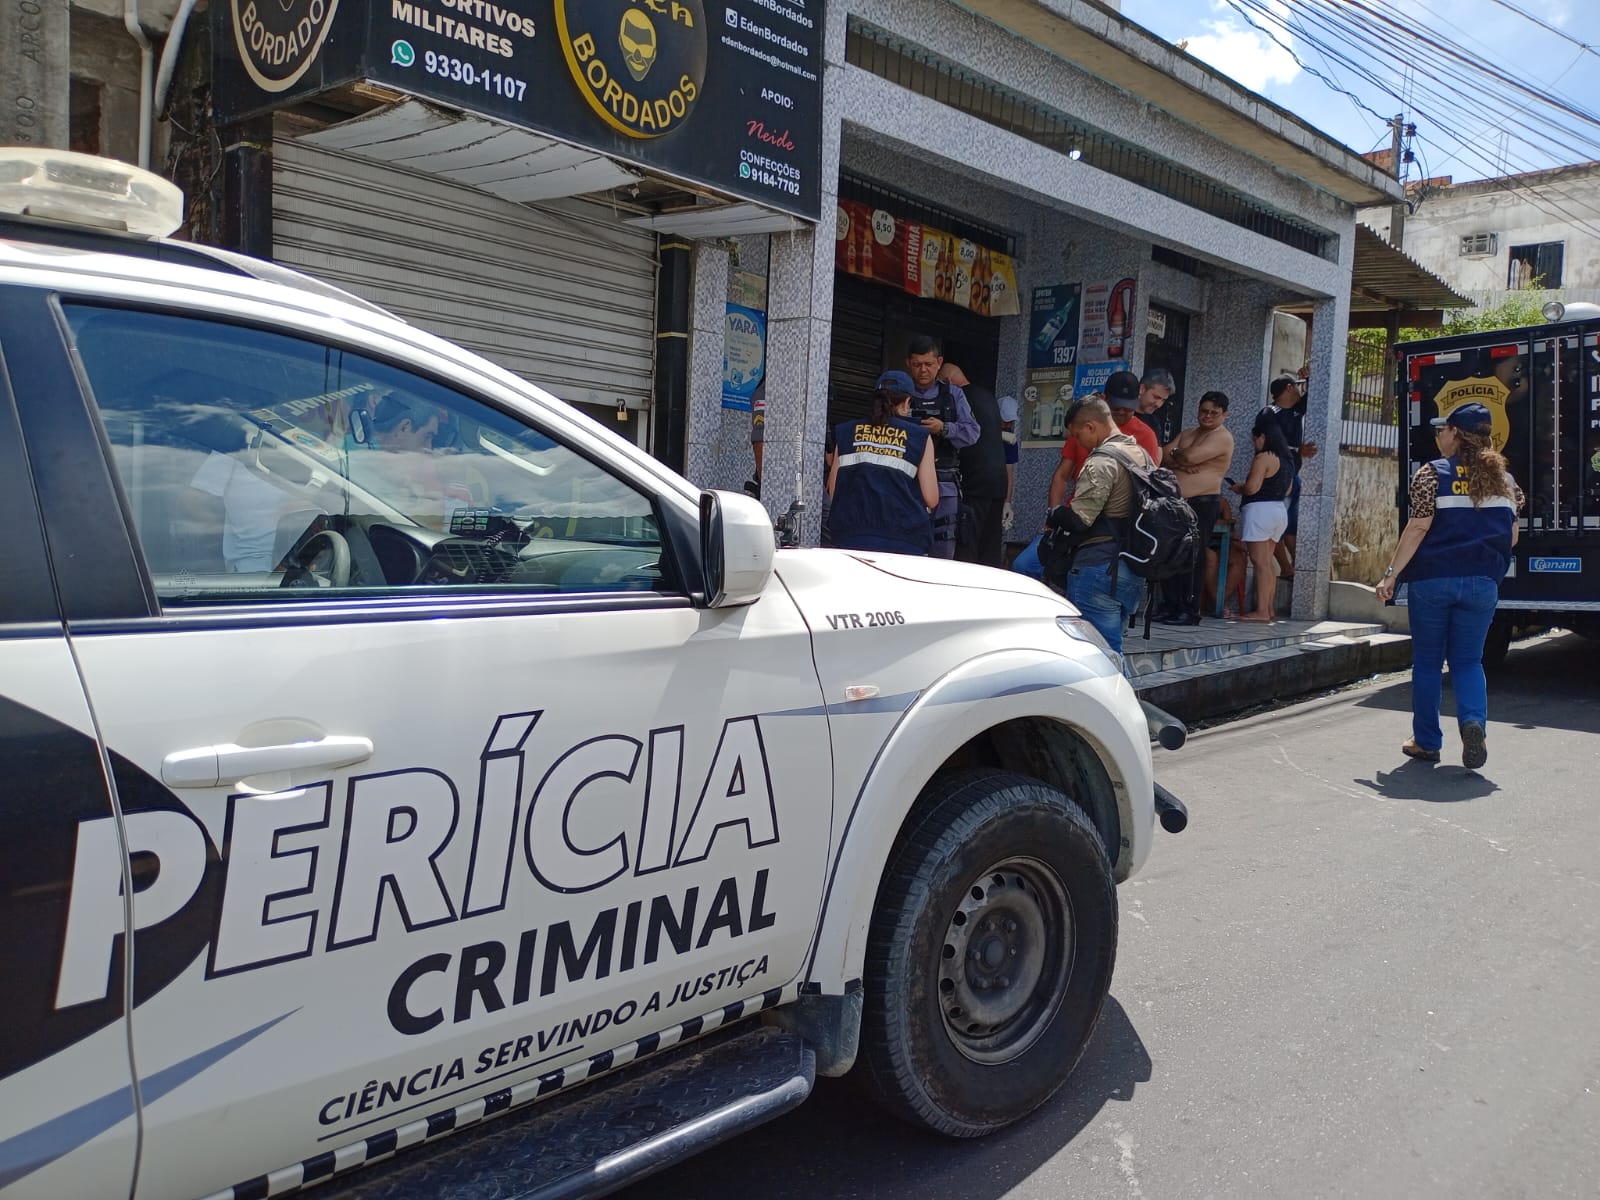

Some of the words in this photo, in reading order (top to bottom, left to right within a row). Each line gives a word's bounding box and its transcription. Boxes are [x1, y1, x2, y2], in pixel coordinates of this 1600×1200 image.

[392, 0, 514, 58] MILITARES
[740, 16, 809, 57] EdenBordados
[424, 50, 527, 102] 9330-1107
[721, 35, 817, 82] edenbordados@hotmail.com
[573, 32, 697, 130] BORDADOS
[760, 87, 794, 110] APOIO:
[746, 120, 795, 151] Neide
[740, 149, 801, 180] CONFECÇÕES
[751, 168, 800, 196] 9184-7702
[907, 225, 921, 282] BRAHMA
[1450, 386, 1495, 400] POLÍCIA
[854, 433, 907, 449] CRIMINAL
[855, 445, 904, 459] AMAZONAS
[825, 613, 864, 630] VTR
[865, 610, 905, 628] 2006
[54, 709, 780, 1011] PERÍCIA
[387, 869, 777, 1036] CRIMINAL
[318, 1058, 466, 1127] CIÊNCIA
[475, 1000, 637, 1075] SERVINDO
[640, 991, 663, 1018] A
[667, 954, 769, 1010] JUSTIÇA
